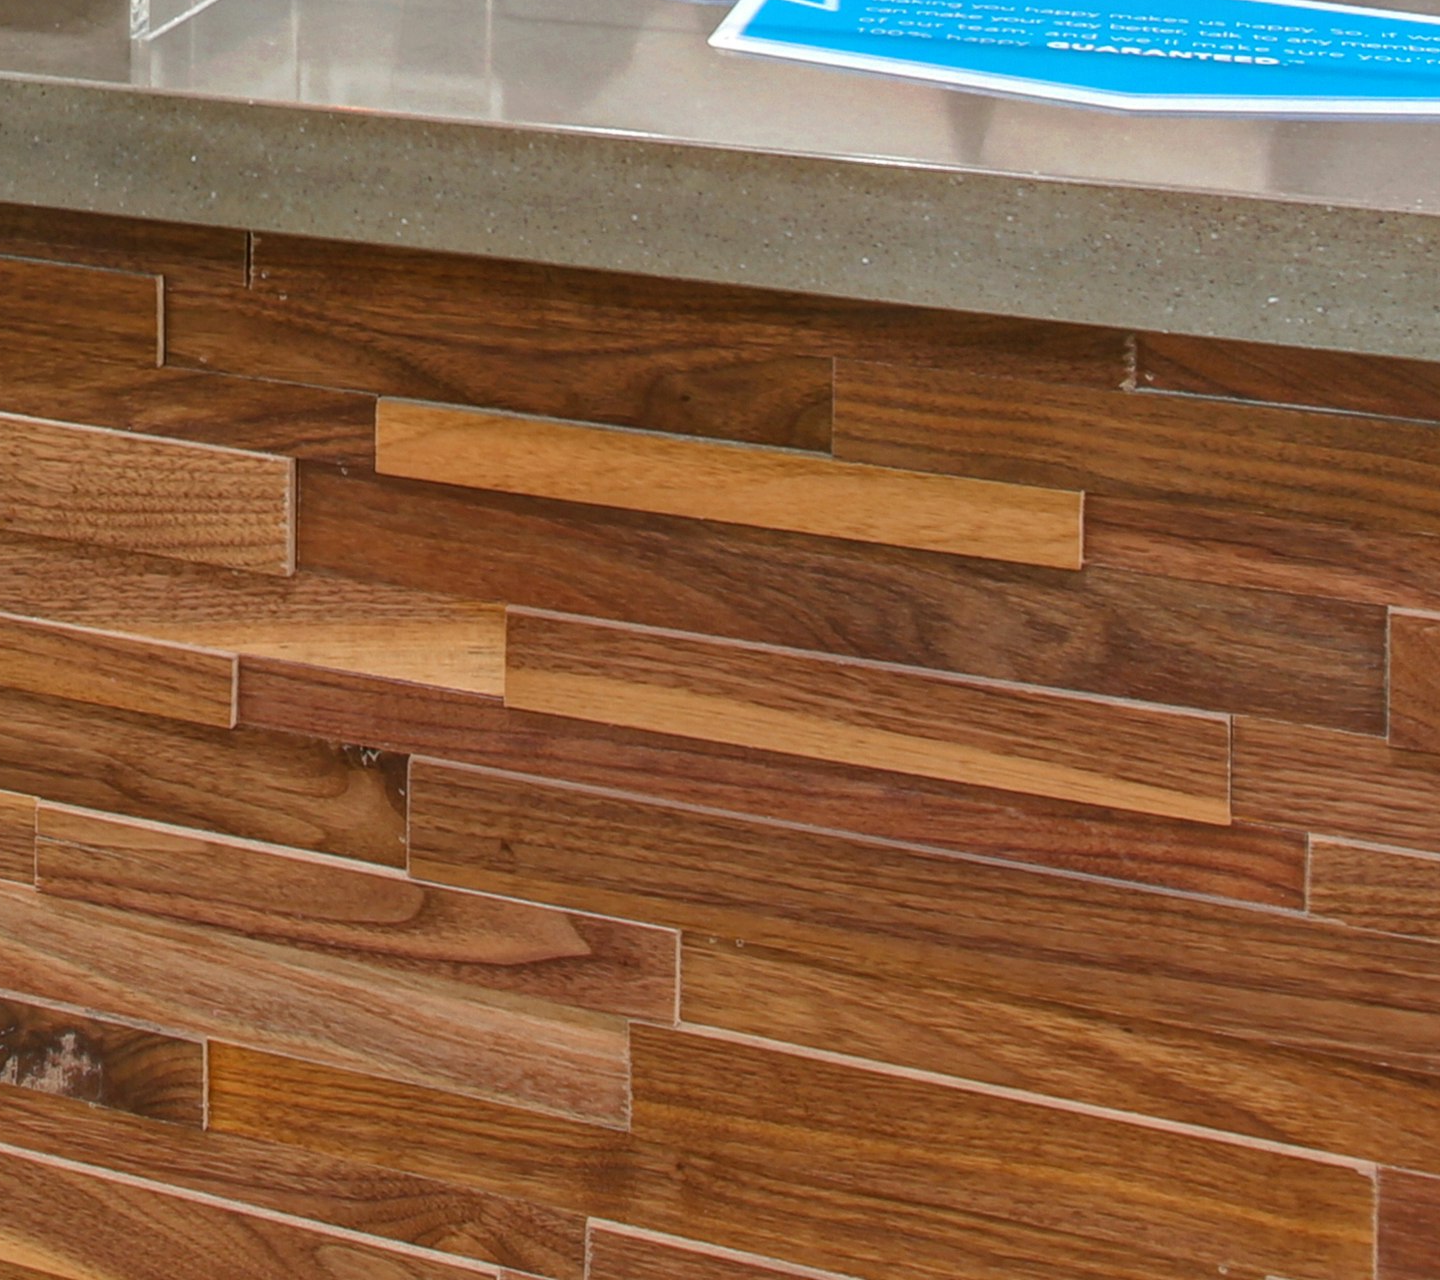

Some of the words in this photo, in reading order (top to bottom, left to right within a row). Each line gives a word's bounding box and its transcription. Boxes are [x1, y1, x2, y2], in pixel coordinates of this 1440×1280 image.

[865, 6, 908, 15] can
[916, 9, 984, 20] make
[990, 16, 1047, 26] your
[1052, 20, 1103, 30] stay
[1199, 30, 1241, 40] talk
[1253, 34, 1278, 43] to
[1287, 38, 1333, 48] any
[972, 2, 1016, 12] you
[1024, 5, 1102, 19] happy
[1109, 13, 1190, 25] makes
[899, 20, 945, 29] our
[1044, 30, 1099, 40] and
[1192, 42, 1271, 53] make
[1283, 48, 1345, 59] sure
[946, 33, 1032, 47] happy
